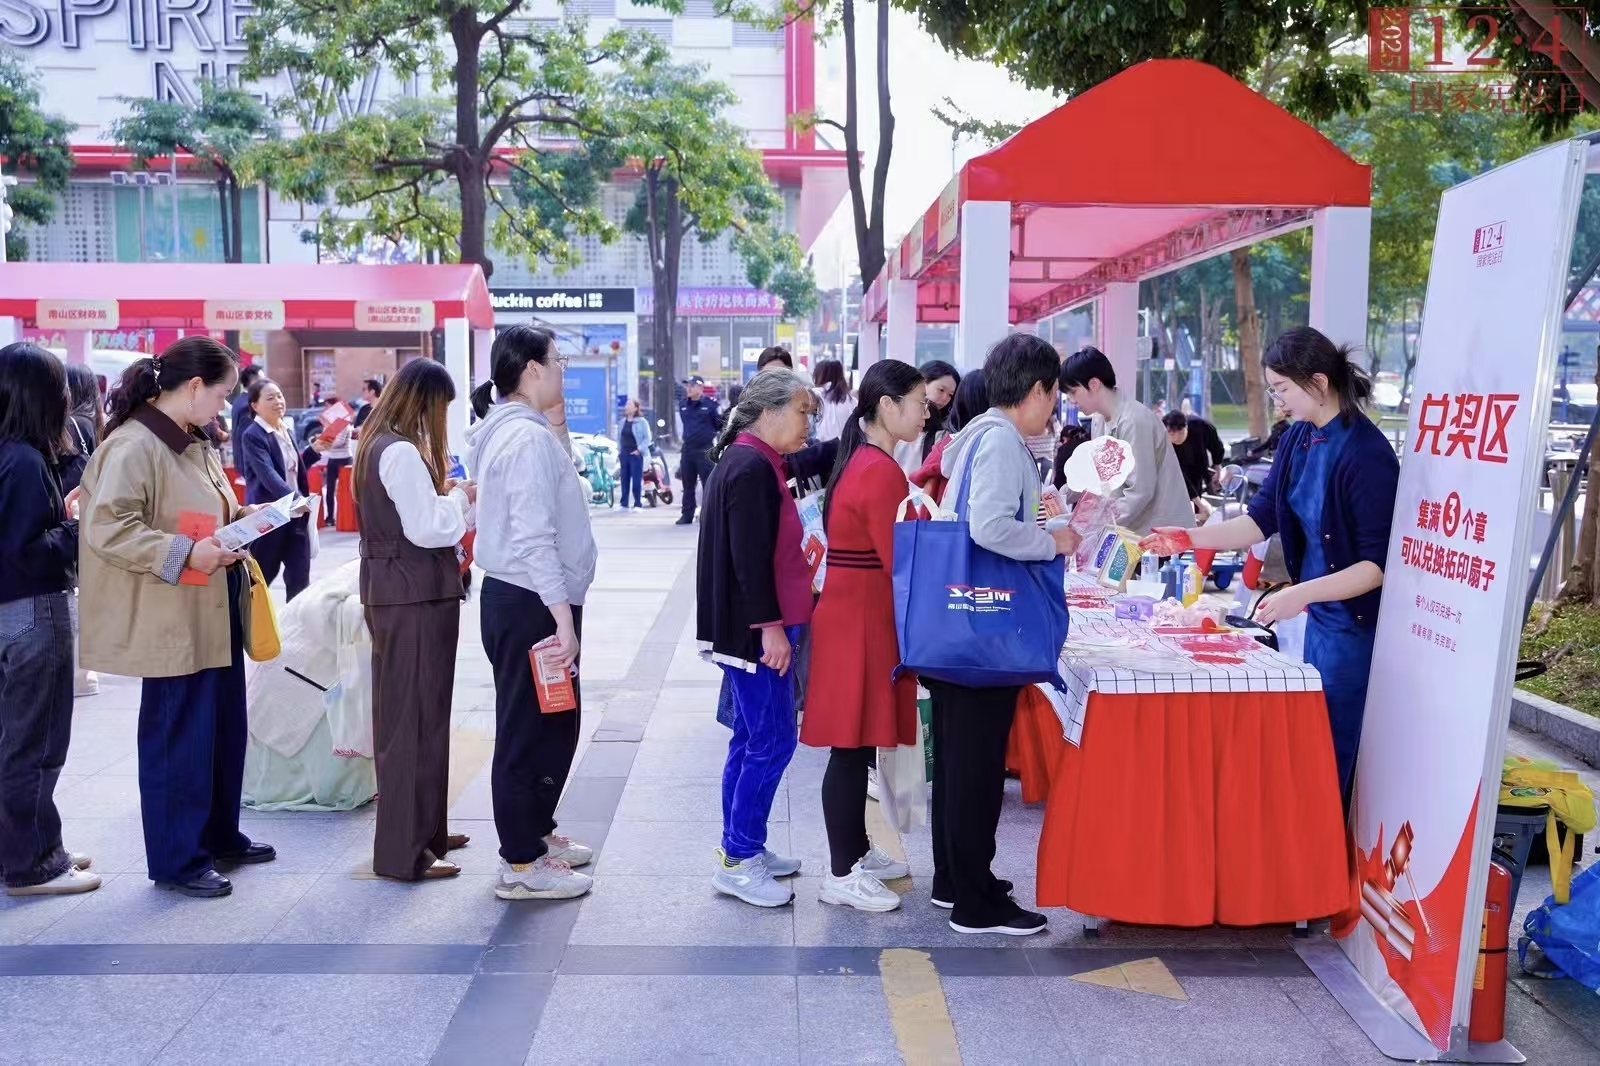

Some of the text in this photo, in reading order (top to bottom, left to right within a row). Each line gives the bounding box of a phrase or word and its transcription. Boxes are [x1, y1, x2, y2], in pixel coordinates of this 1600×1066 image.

[536, 292, 583, 308] coffee
[1414, 393, 1520, 464] 兑奖区
[1401, 536, 1496, 592] 可以兑换拓印扇子
